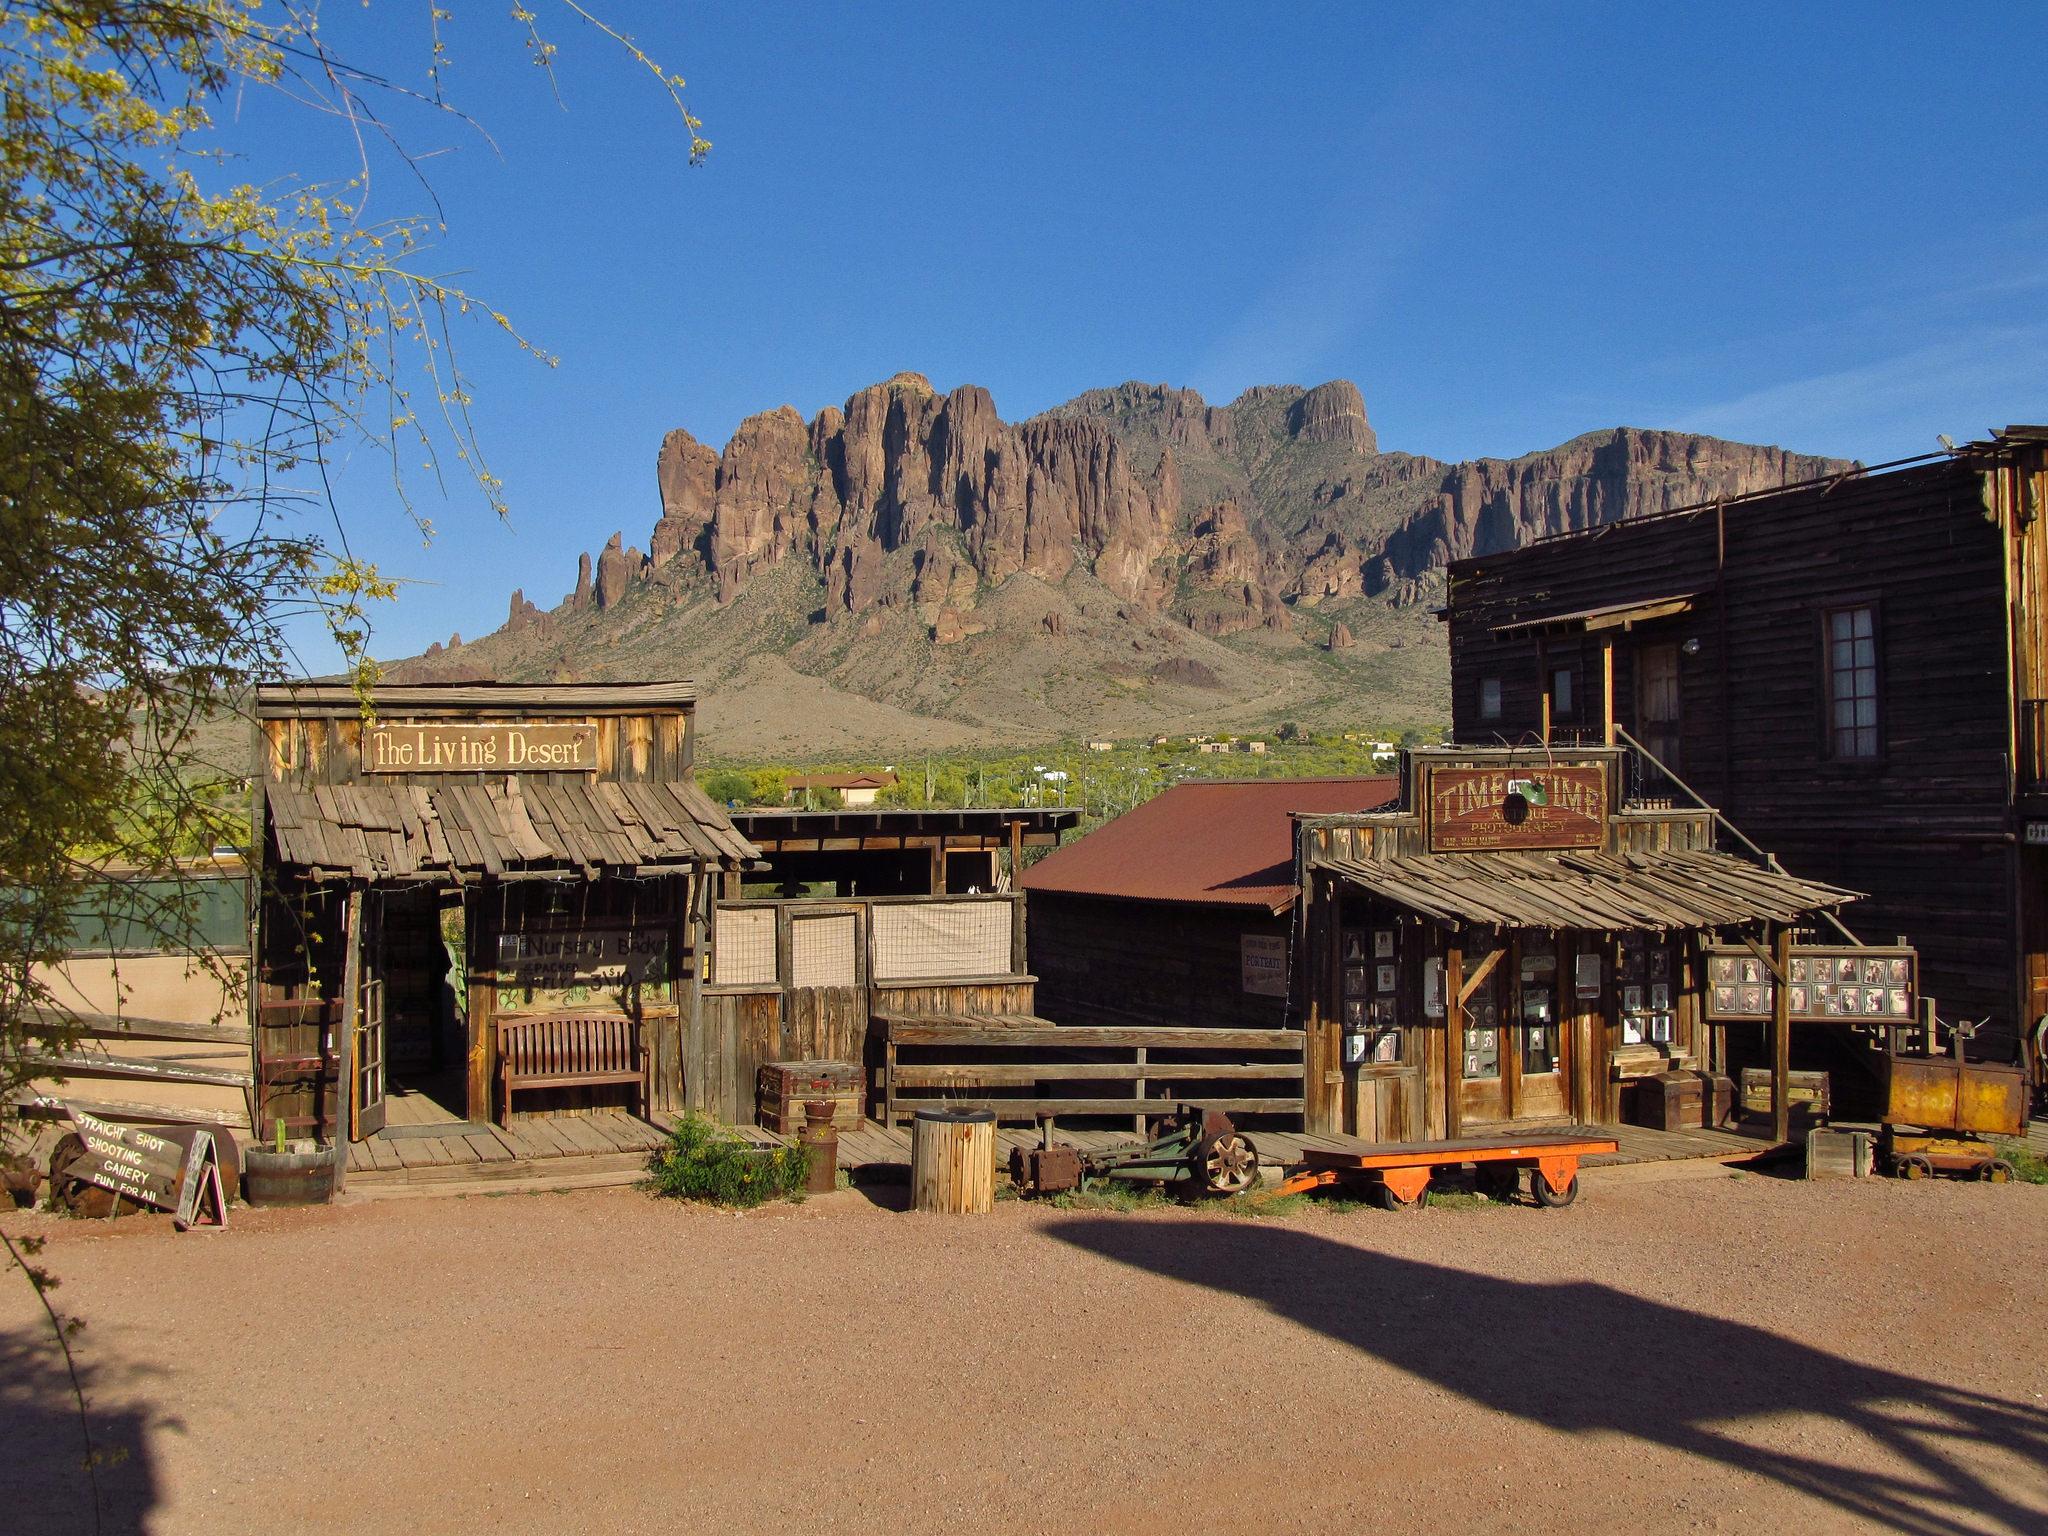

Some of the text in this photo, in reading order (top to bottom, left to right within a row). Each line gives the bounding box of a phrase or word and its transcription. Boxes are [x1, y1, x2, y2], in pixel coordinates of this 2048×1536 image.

[373, 731, 585, 765] The Living Desert
[1437, 774, 1506, 823] TIME
[1470, 820, 1566, 833] PHOTOGRAPHY
[528, 936, 603, 957] Nursery
[76, 1113, 165, 1152] STRAIGHT SHOT
[87, 1136, 143, 1165] SHOOTING
[94, 1173, 115, 1189] FUN
[120, 1183, 139, 1196] FOR
